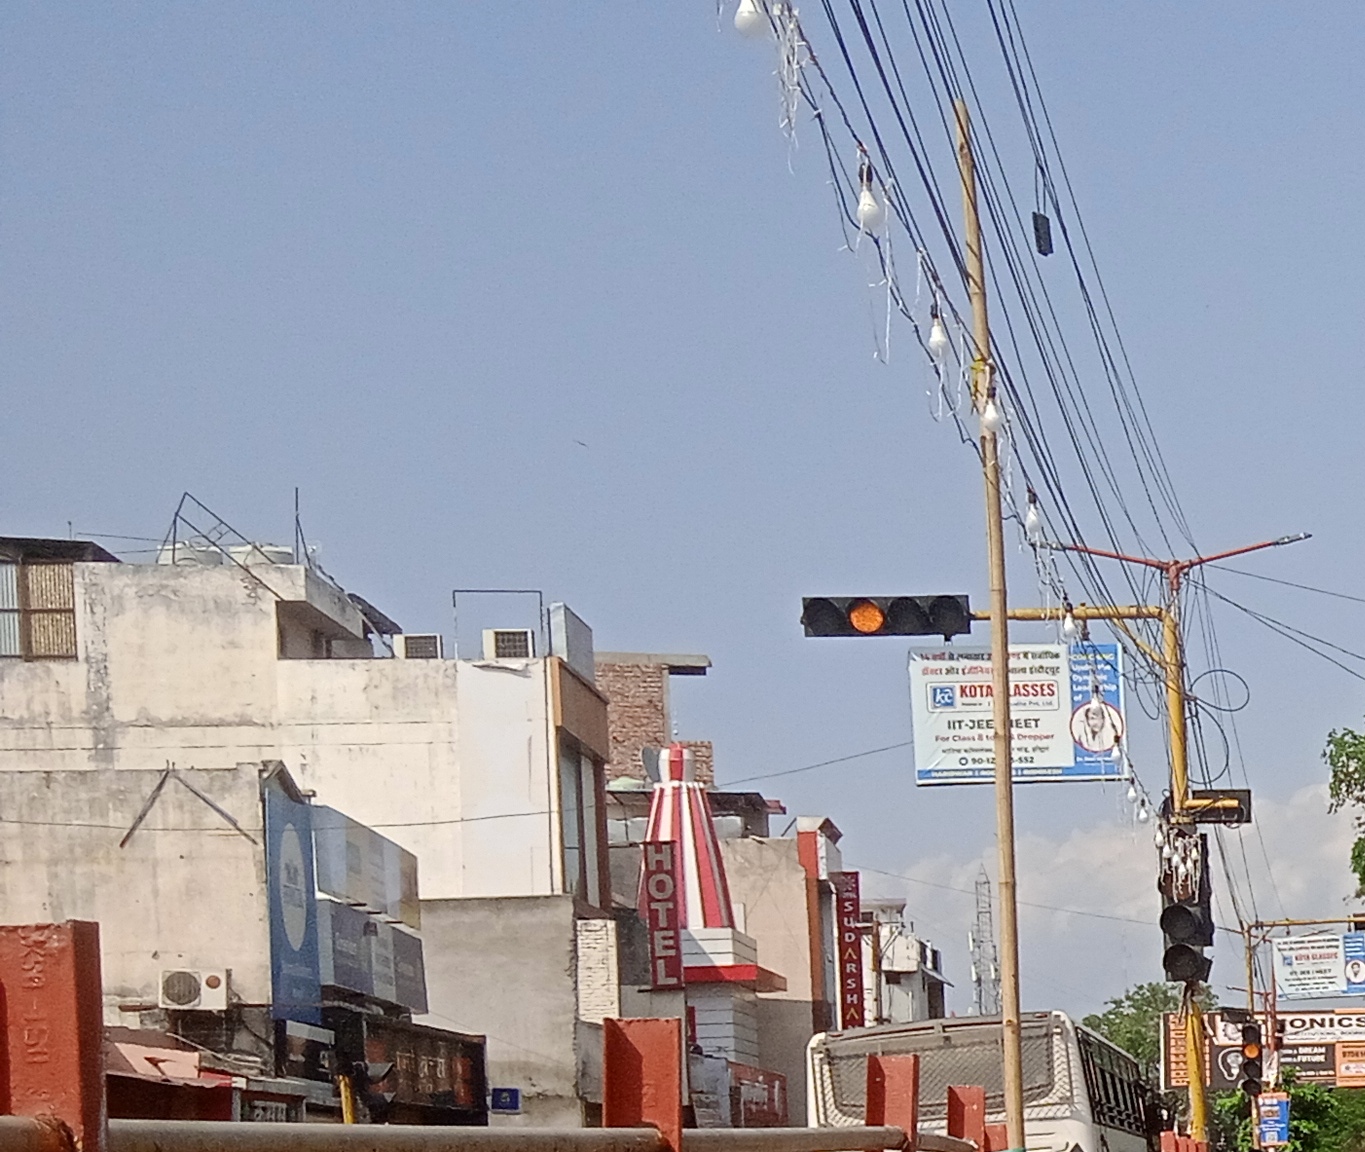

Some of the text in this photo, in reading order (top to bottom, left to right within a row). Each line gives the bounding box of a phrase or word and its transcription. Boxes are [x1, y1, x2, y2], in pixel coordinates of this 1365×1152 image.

[960, 683, 1055, 698] KOTA ASSES
[935, 734, 951, 743] For
[951, 733, 976, 742] Class
[646, 844, 678, 986] HOTEL
